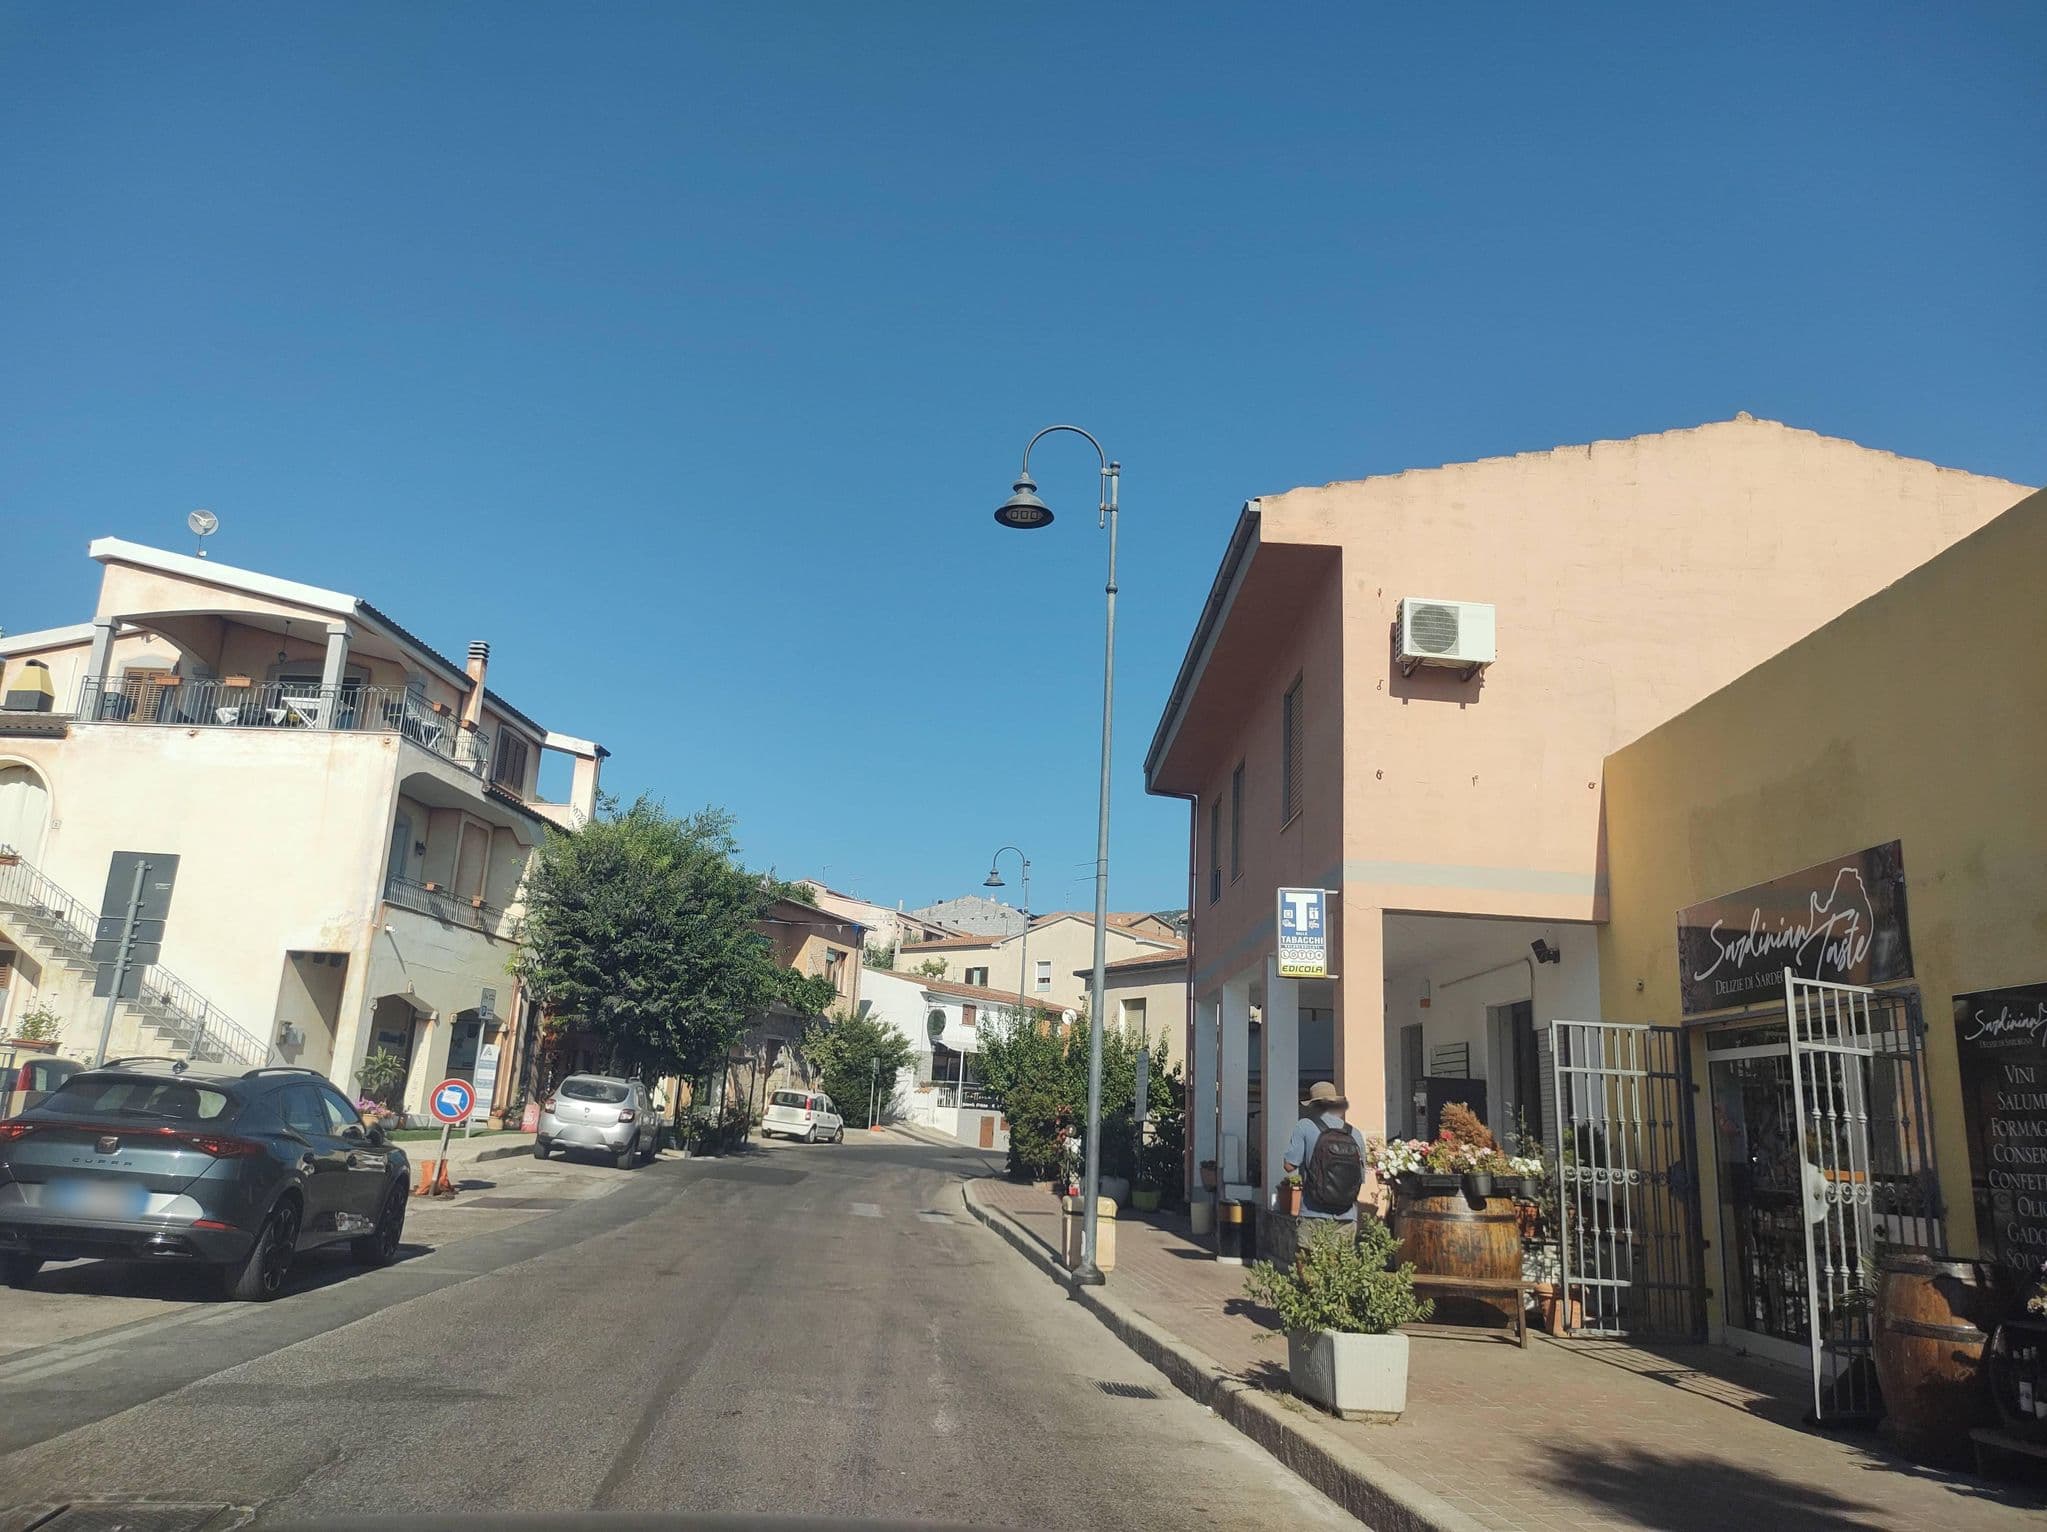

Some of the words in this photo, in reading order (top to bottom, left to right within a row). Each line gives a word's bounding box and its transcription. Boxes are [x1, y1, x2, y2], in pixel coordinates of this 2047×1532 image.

[1285, 893, 1318, 931] T
[1281, 936, 1323, 945] TABACCHI
[1695, 908, 1810, 981] Sardinian
[1796, 908, 1866, 981] Taste
[1282, 965, 1323, 973] EDICOLA
[1715, 977, 1744, 996] DELIZIE
[1964, 1006, 2038, 1040] Sardinian
[2004, 1065, 2036, 1084] VINI
